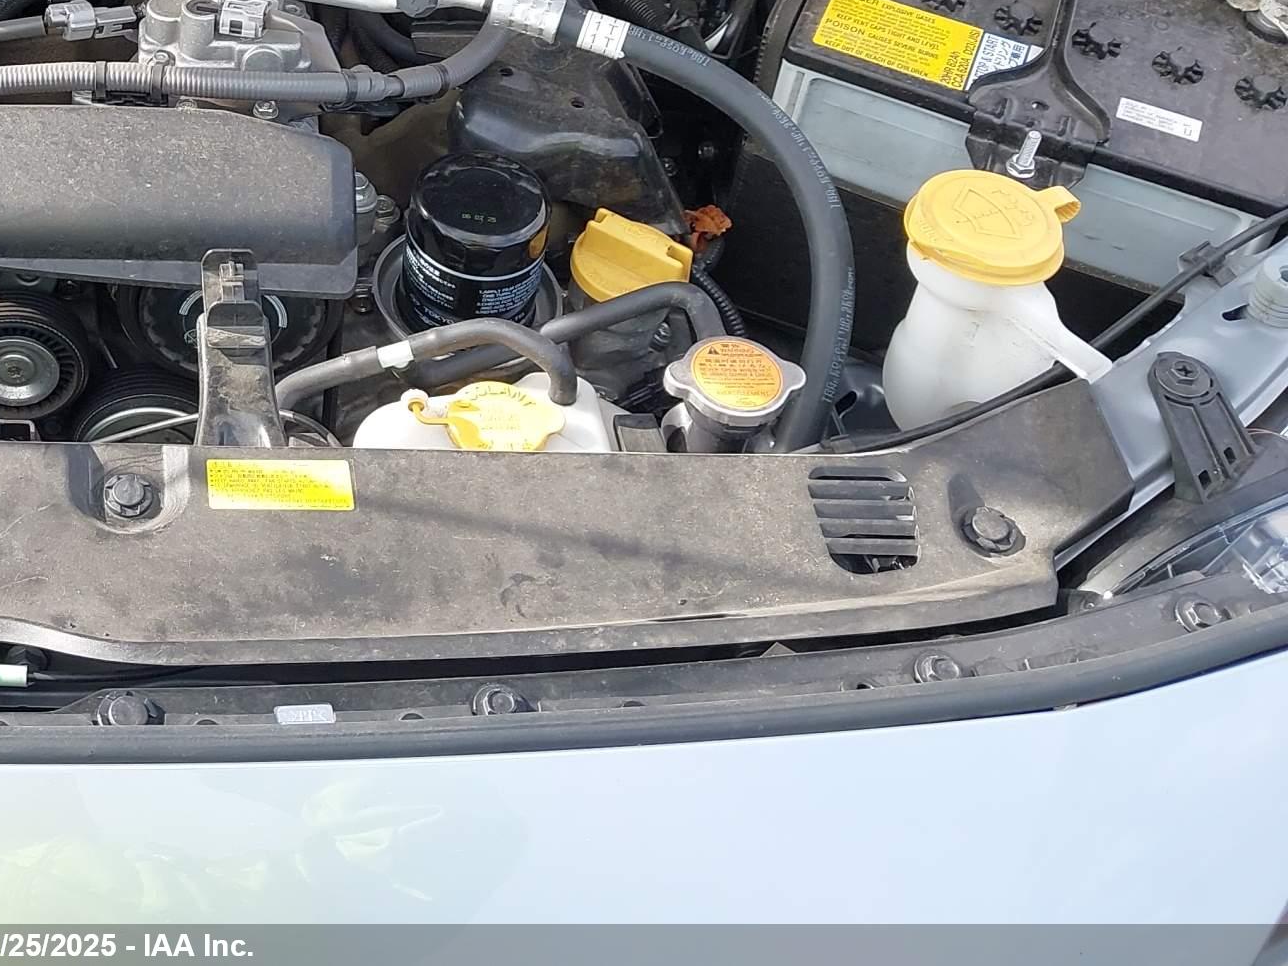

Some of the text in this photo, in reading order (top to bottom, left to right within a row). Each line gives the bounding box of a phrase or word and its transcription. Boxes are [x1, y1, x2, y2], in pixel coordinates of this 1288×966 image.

[881, 3, 914, 17] EXPLOSIVE
[825, 17, 865, 35] POISON
[867, 32, 892, 44] CAUSES
[893, 41, 915, 51] SEVERE
[836, 13, 852, 21] KEEP
[853, 18, 868, 27] VENT
[870, 23, 886, 32] CAPS
[887, 29, 905, 39] TIGHT
[921, 40, 939, 50] LEVEL
[982, 35, 999, 56] START
[824, 39, 840, 48] KEEP
[864, 52, 885, 63] REACH
[896, 63, 928, 76] CHILDREN
[957, 56, 970, 73] 620A
[940, 65, 954, 84] 20HR
[951, 72, 964, 88] CCA
